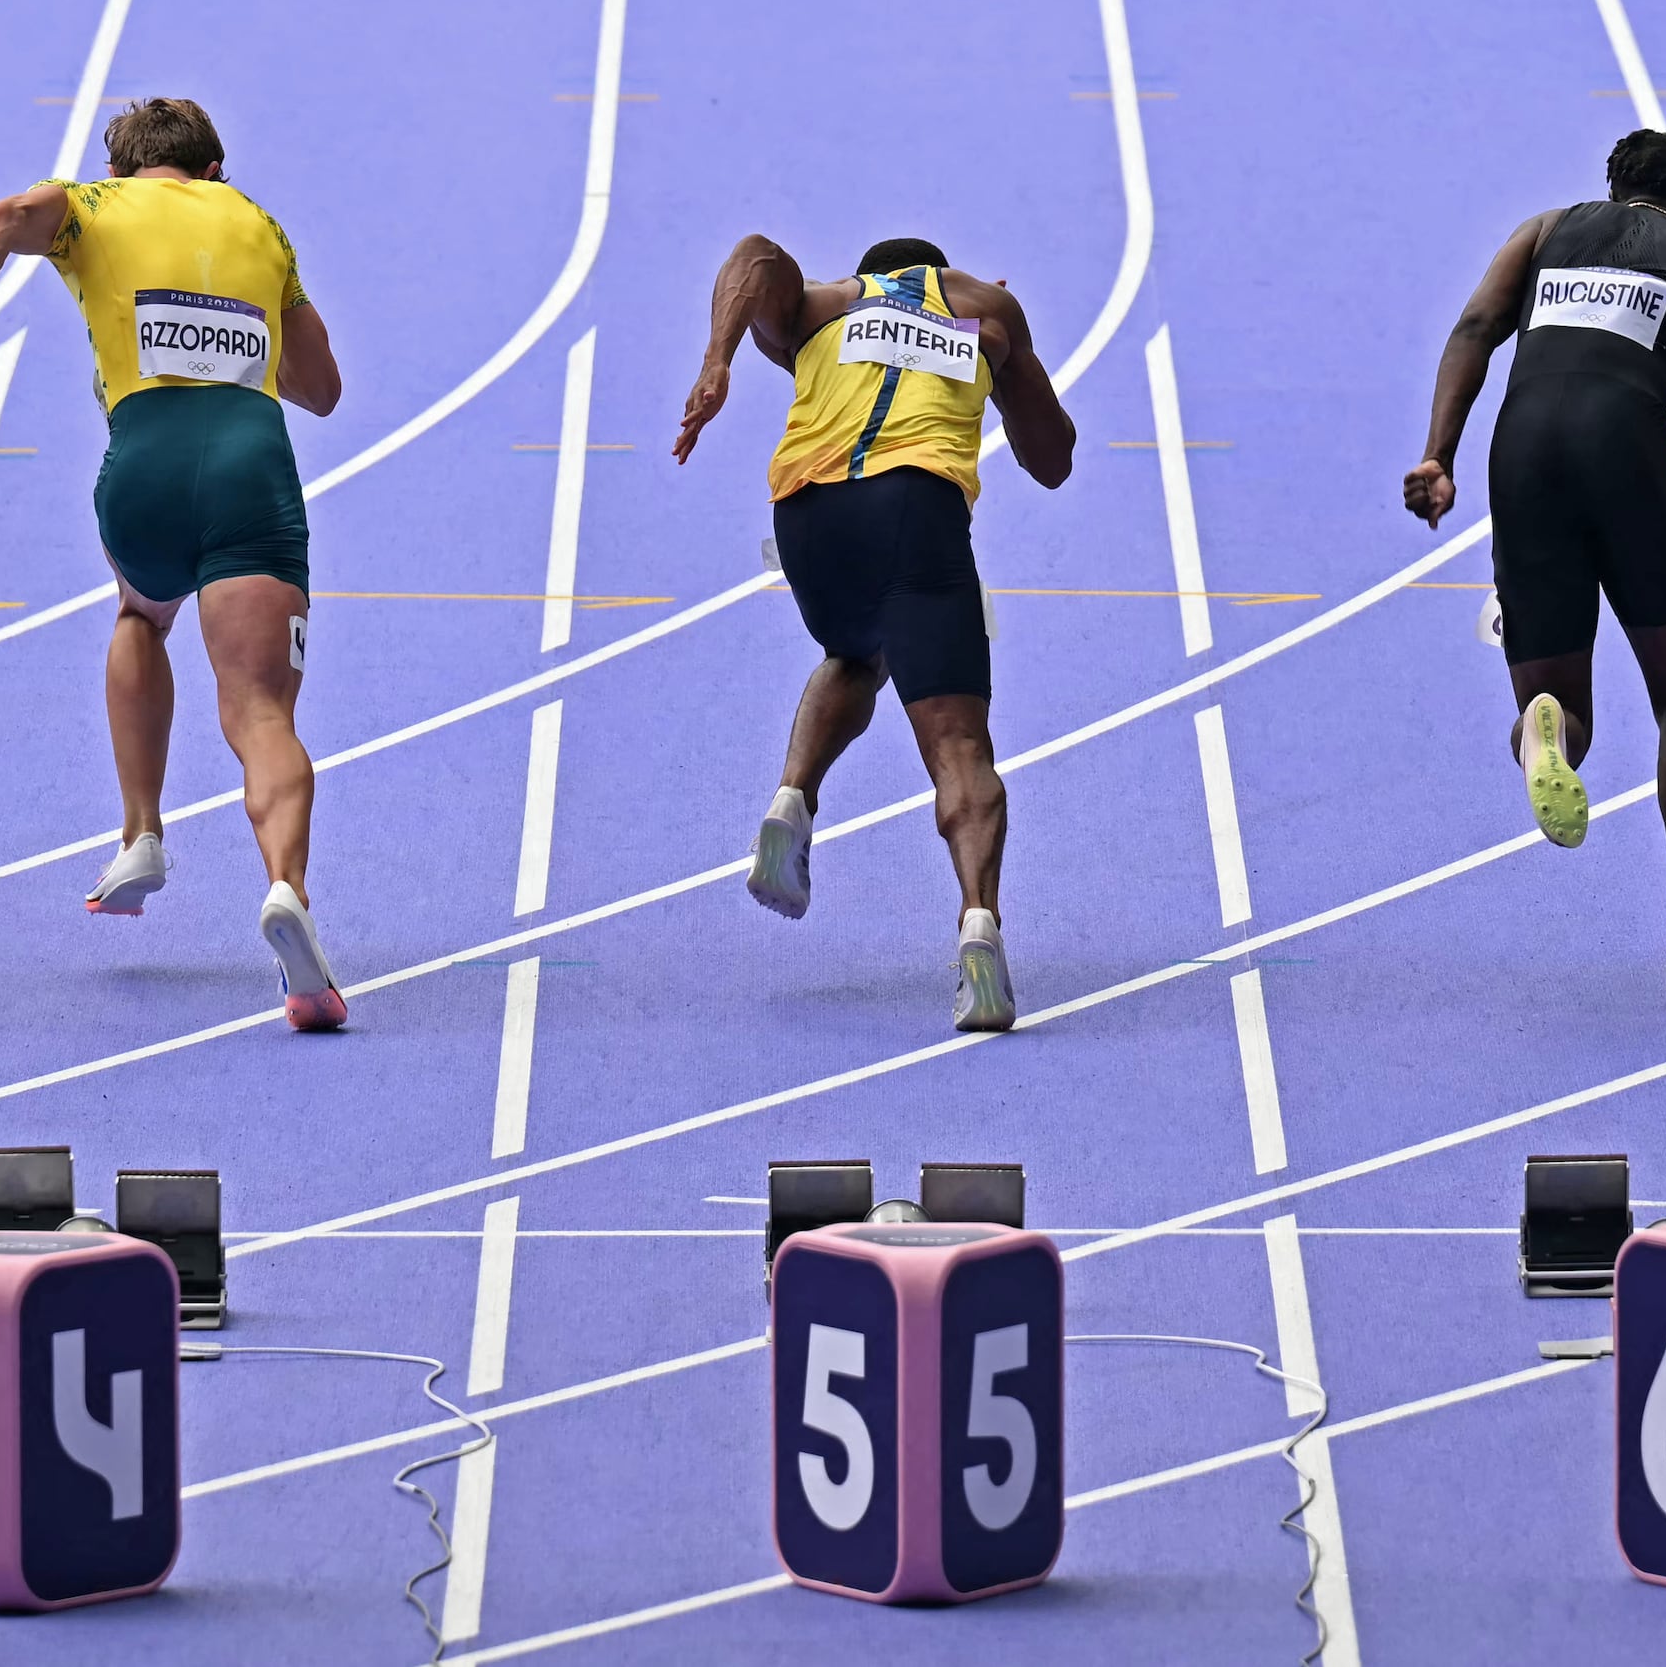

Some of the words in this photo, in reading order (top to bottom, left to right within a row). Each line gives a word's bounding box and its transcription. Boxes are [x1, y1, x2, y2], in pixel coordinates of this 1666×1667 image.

[171, 293, 204, 305] PARIS
[207, 298, 237, 309] 2024
[880, 297, 912, 312] PARIS
[916, 308, 944, 324] 2024
[1540, 281, 1664, 321] AUGUSTINE
[141, 321, 266, 361] AZZOPARDI
[847, 319, 973, 360] RENTERIA
[53, 1328, 143, 1521] 4
[798, 1322, 874, 1531] 5
[963, 1322, 1037, 1531] 5
